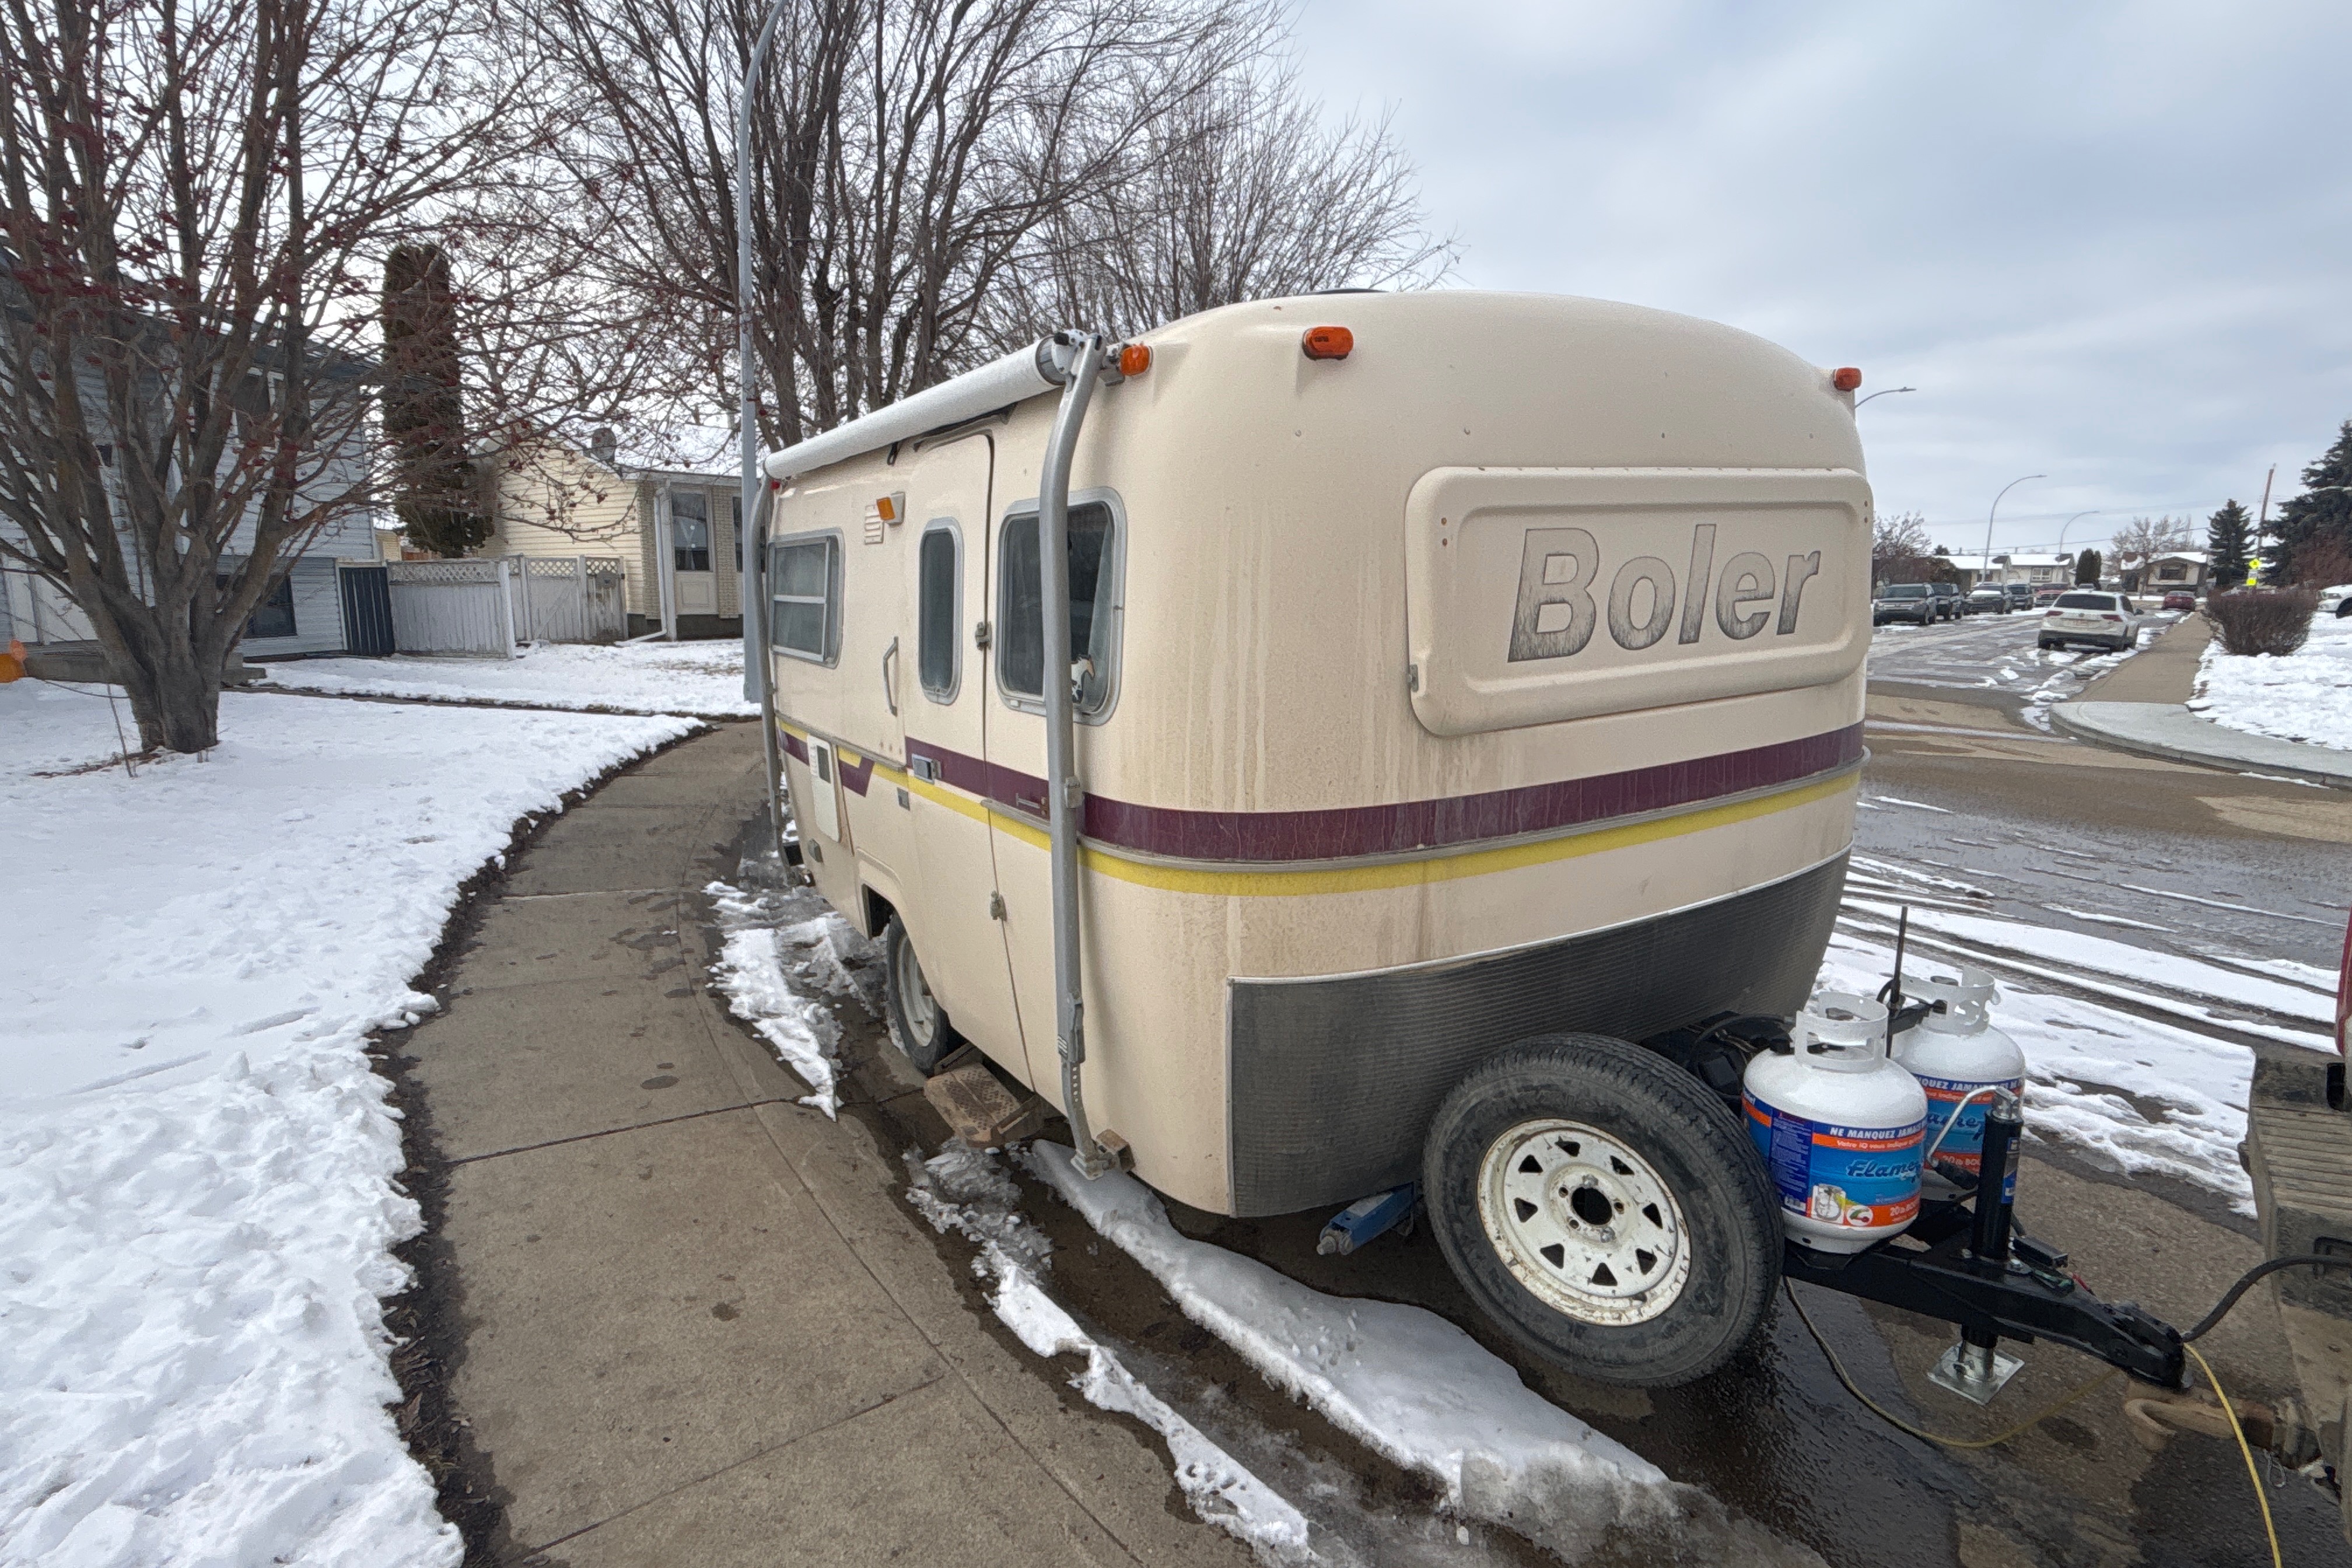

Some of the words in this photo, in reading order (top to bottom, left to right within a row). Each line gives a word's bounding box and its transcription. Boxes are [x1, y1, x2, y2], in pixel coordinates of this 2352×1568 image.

[1508, 523, 1821, 663] Boler
[1829, 1127, 1845, 1137] NE
[1847, 1129, 1896, 1140] MANQUEZ
